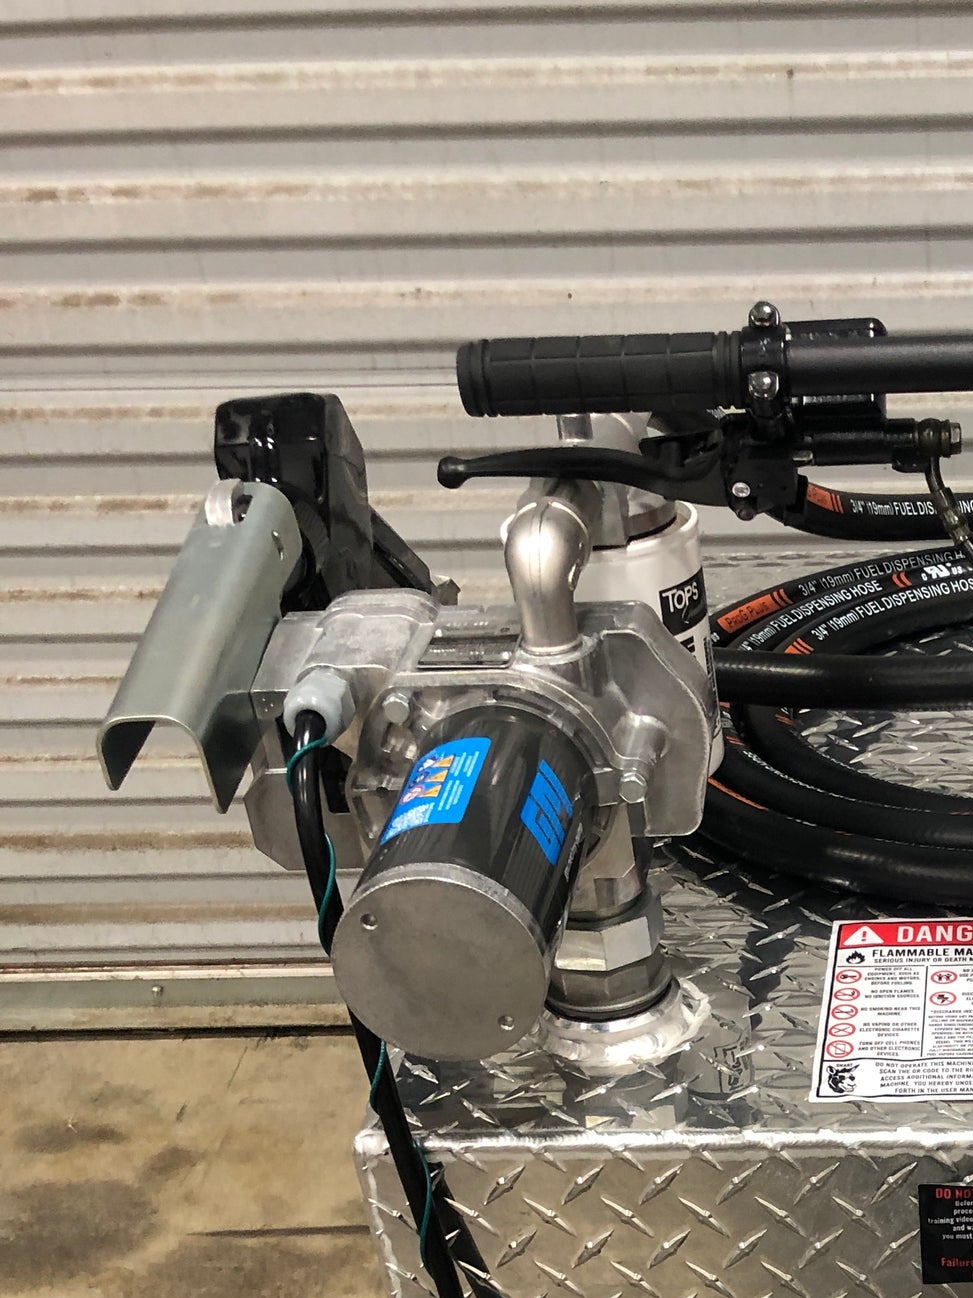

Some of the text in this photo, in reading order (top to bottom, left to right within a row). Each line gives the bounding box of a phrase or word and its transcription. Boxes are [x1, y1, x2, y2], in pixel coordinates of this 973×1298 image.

[894, 502, 918, 516] FUEL
[854, 564, 884, 585] FUEL
[884, 553, 953, 577] DISPENSING
[772, 612, 796, 634] FUEL
[792, 588, 852, 625] DISPENSING
[851, 580, 883, 599] HOSE
[857, 598, 886, 620] FUEL
[885, 582, 953, 611] DISPENSING
[872, 949, 949, 957] FLAMMABLE
[935, 1188, 951, 1199] DO
